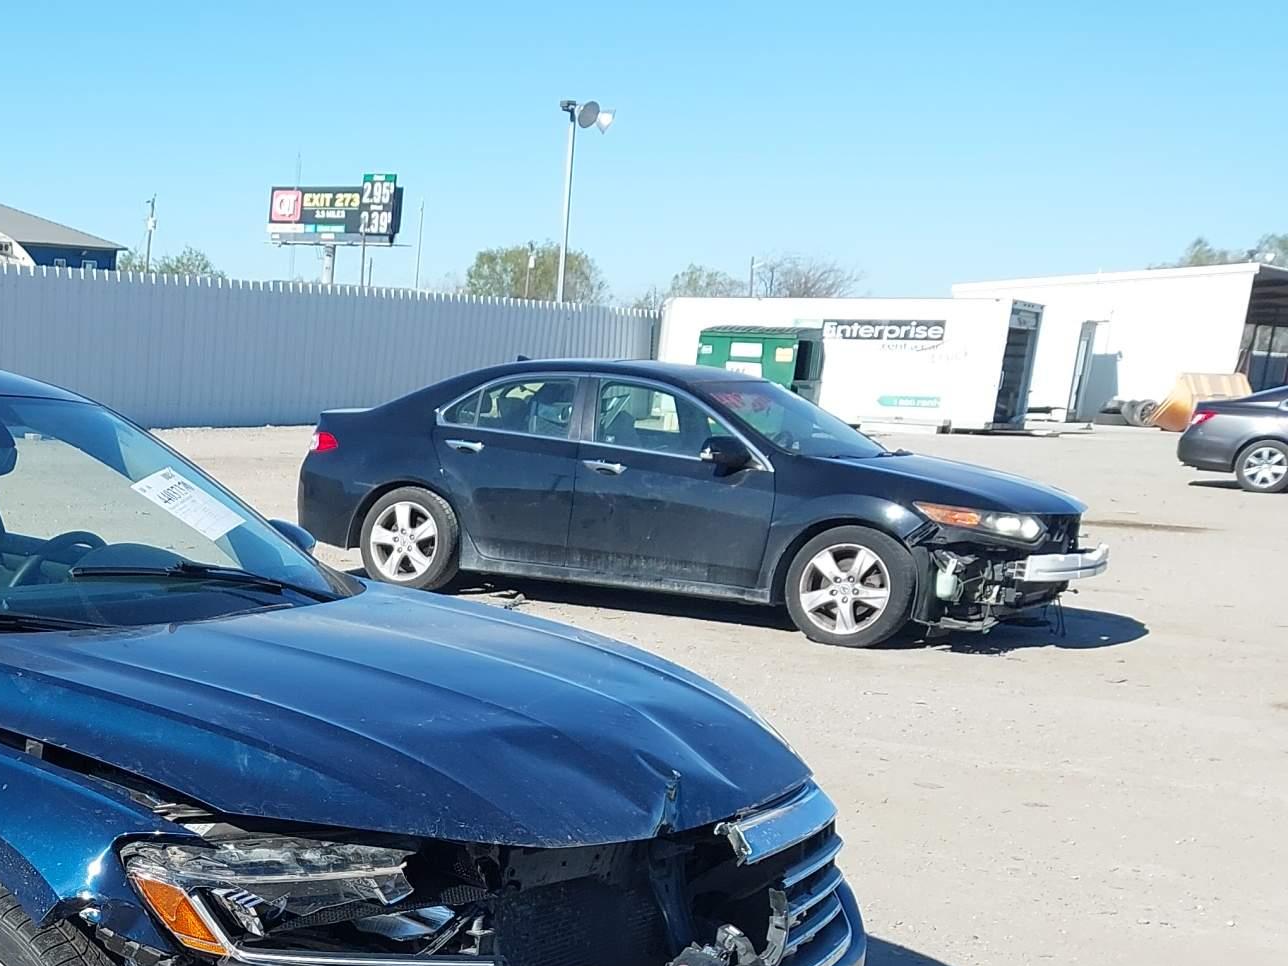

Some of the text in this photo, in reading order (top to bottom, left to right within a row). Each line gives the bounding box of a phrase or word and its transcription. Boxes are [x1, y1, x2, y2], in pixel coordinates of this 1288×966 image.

[303, 193, 360, 207] EXIT 273
[326, 210, 345, 218] MILES
[823, 321, 944, 340] Enterprise
